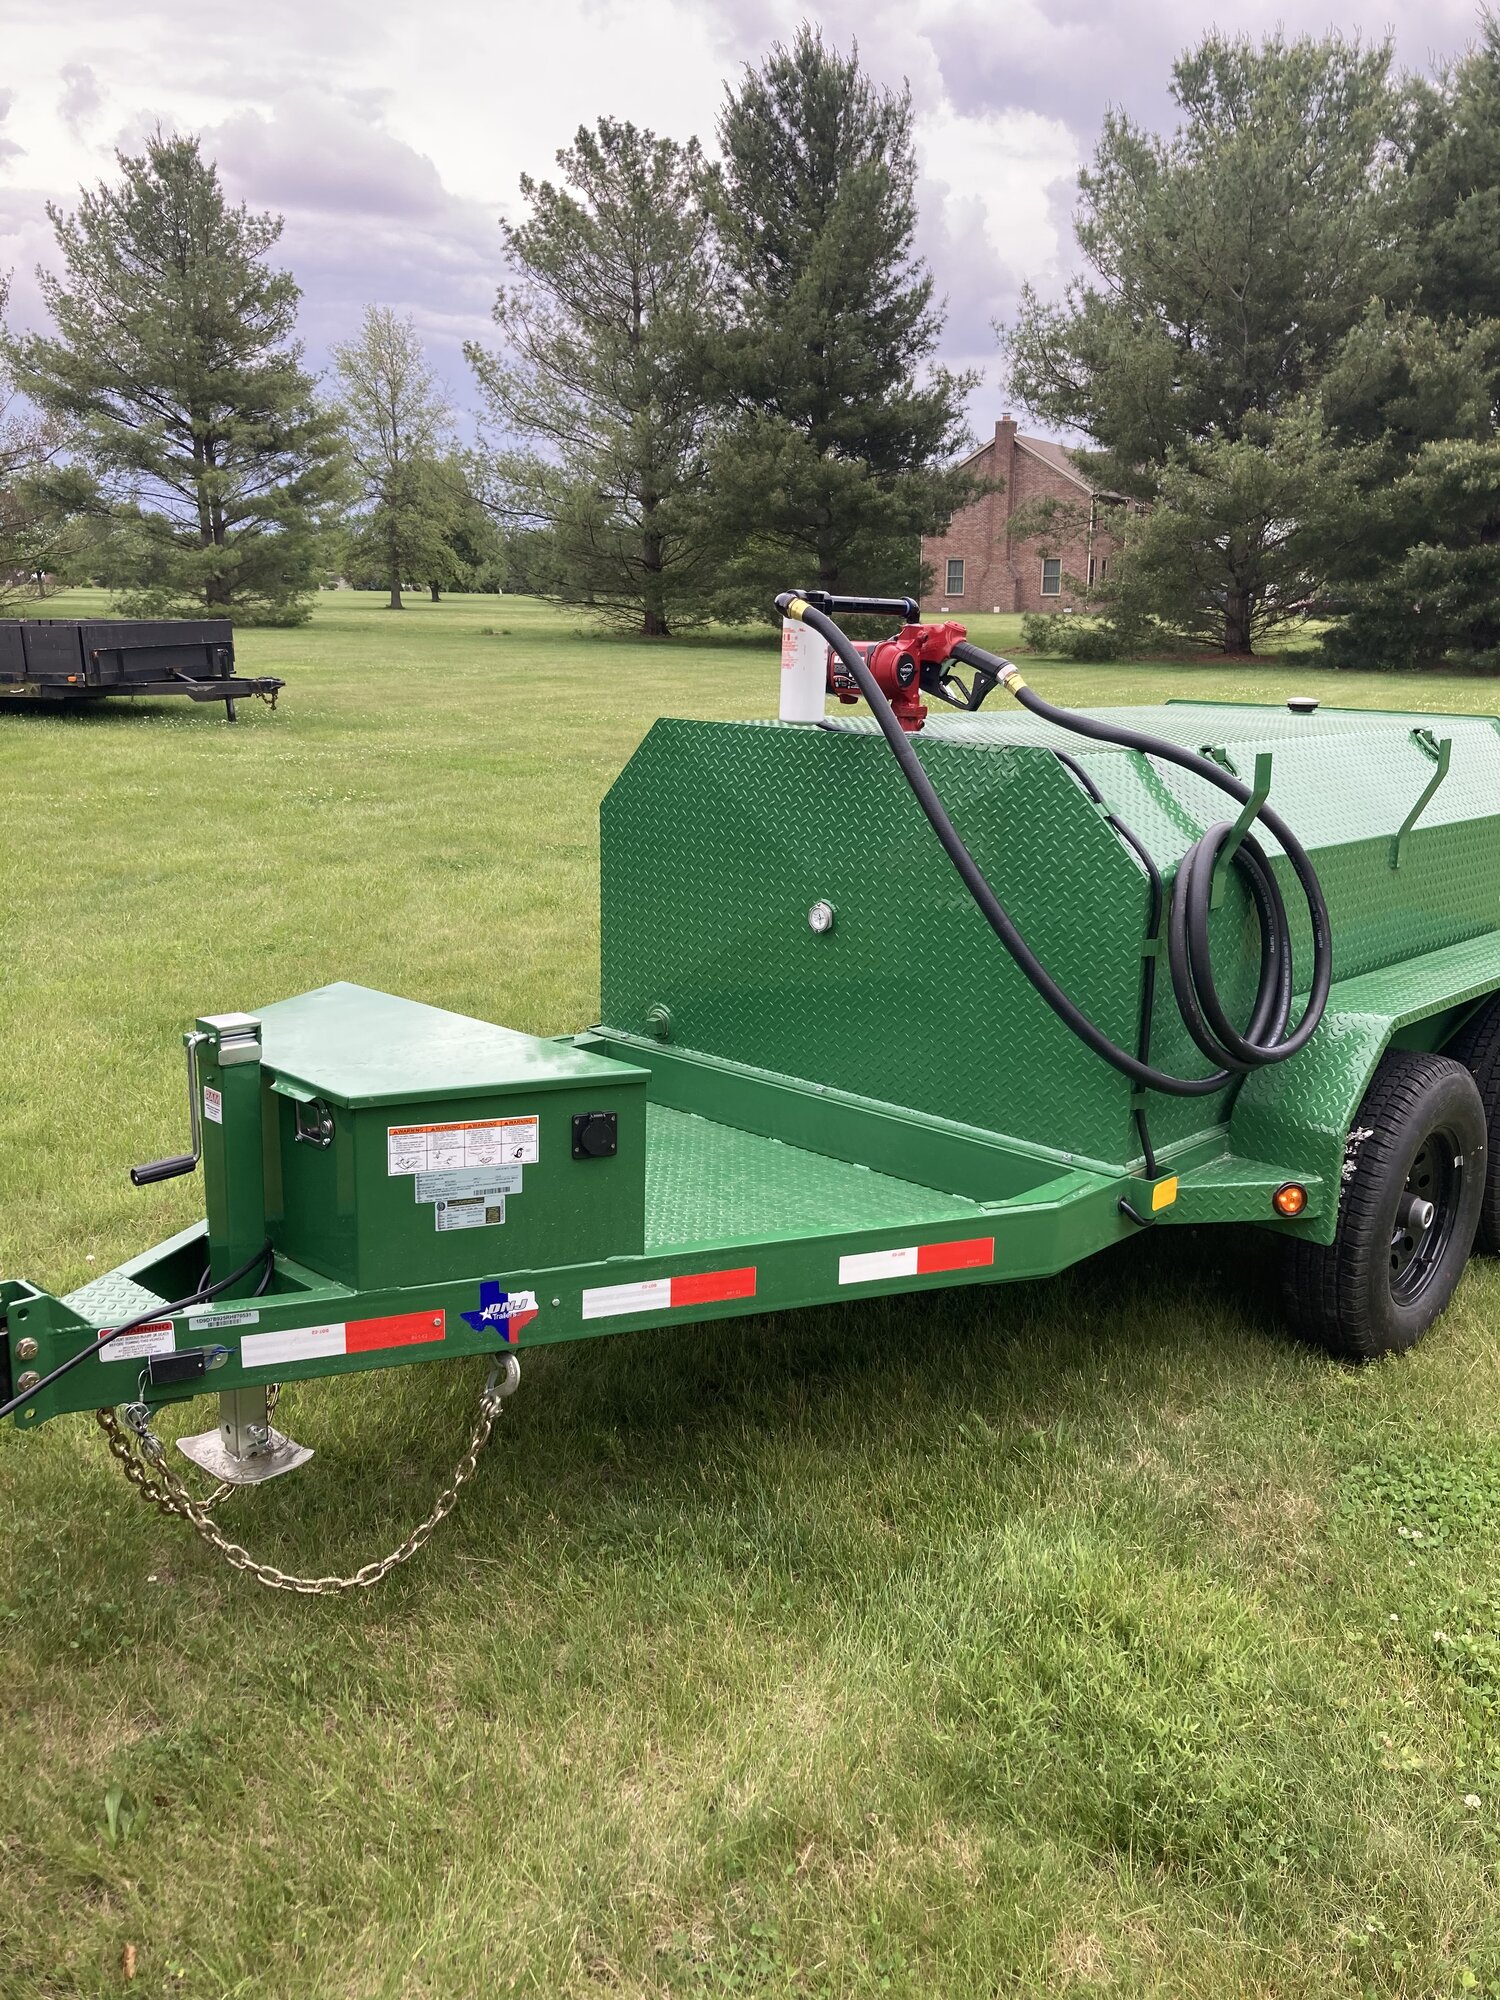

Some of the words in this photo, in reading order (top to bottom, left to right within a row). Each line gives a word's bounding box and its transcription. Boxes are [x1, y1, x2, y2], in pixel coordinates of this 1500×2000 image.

[398, 1127, 424, 1135] WARNING
[487, 1298, 529, 1314] DNJ
[493, 1312, 517, 1320] Trailers
